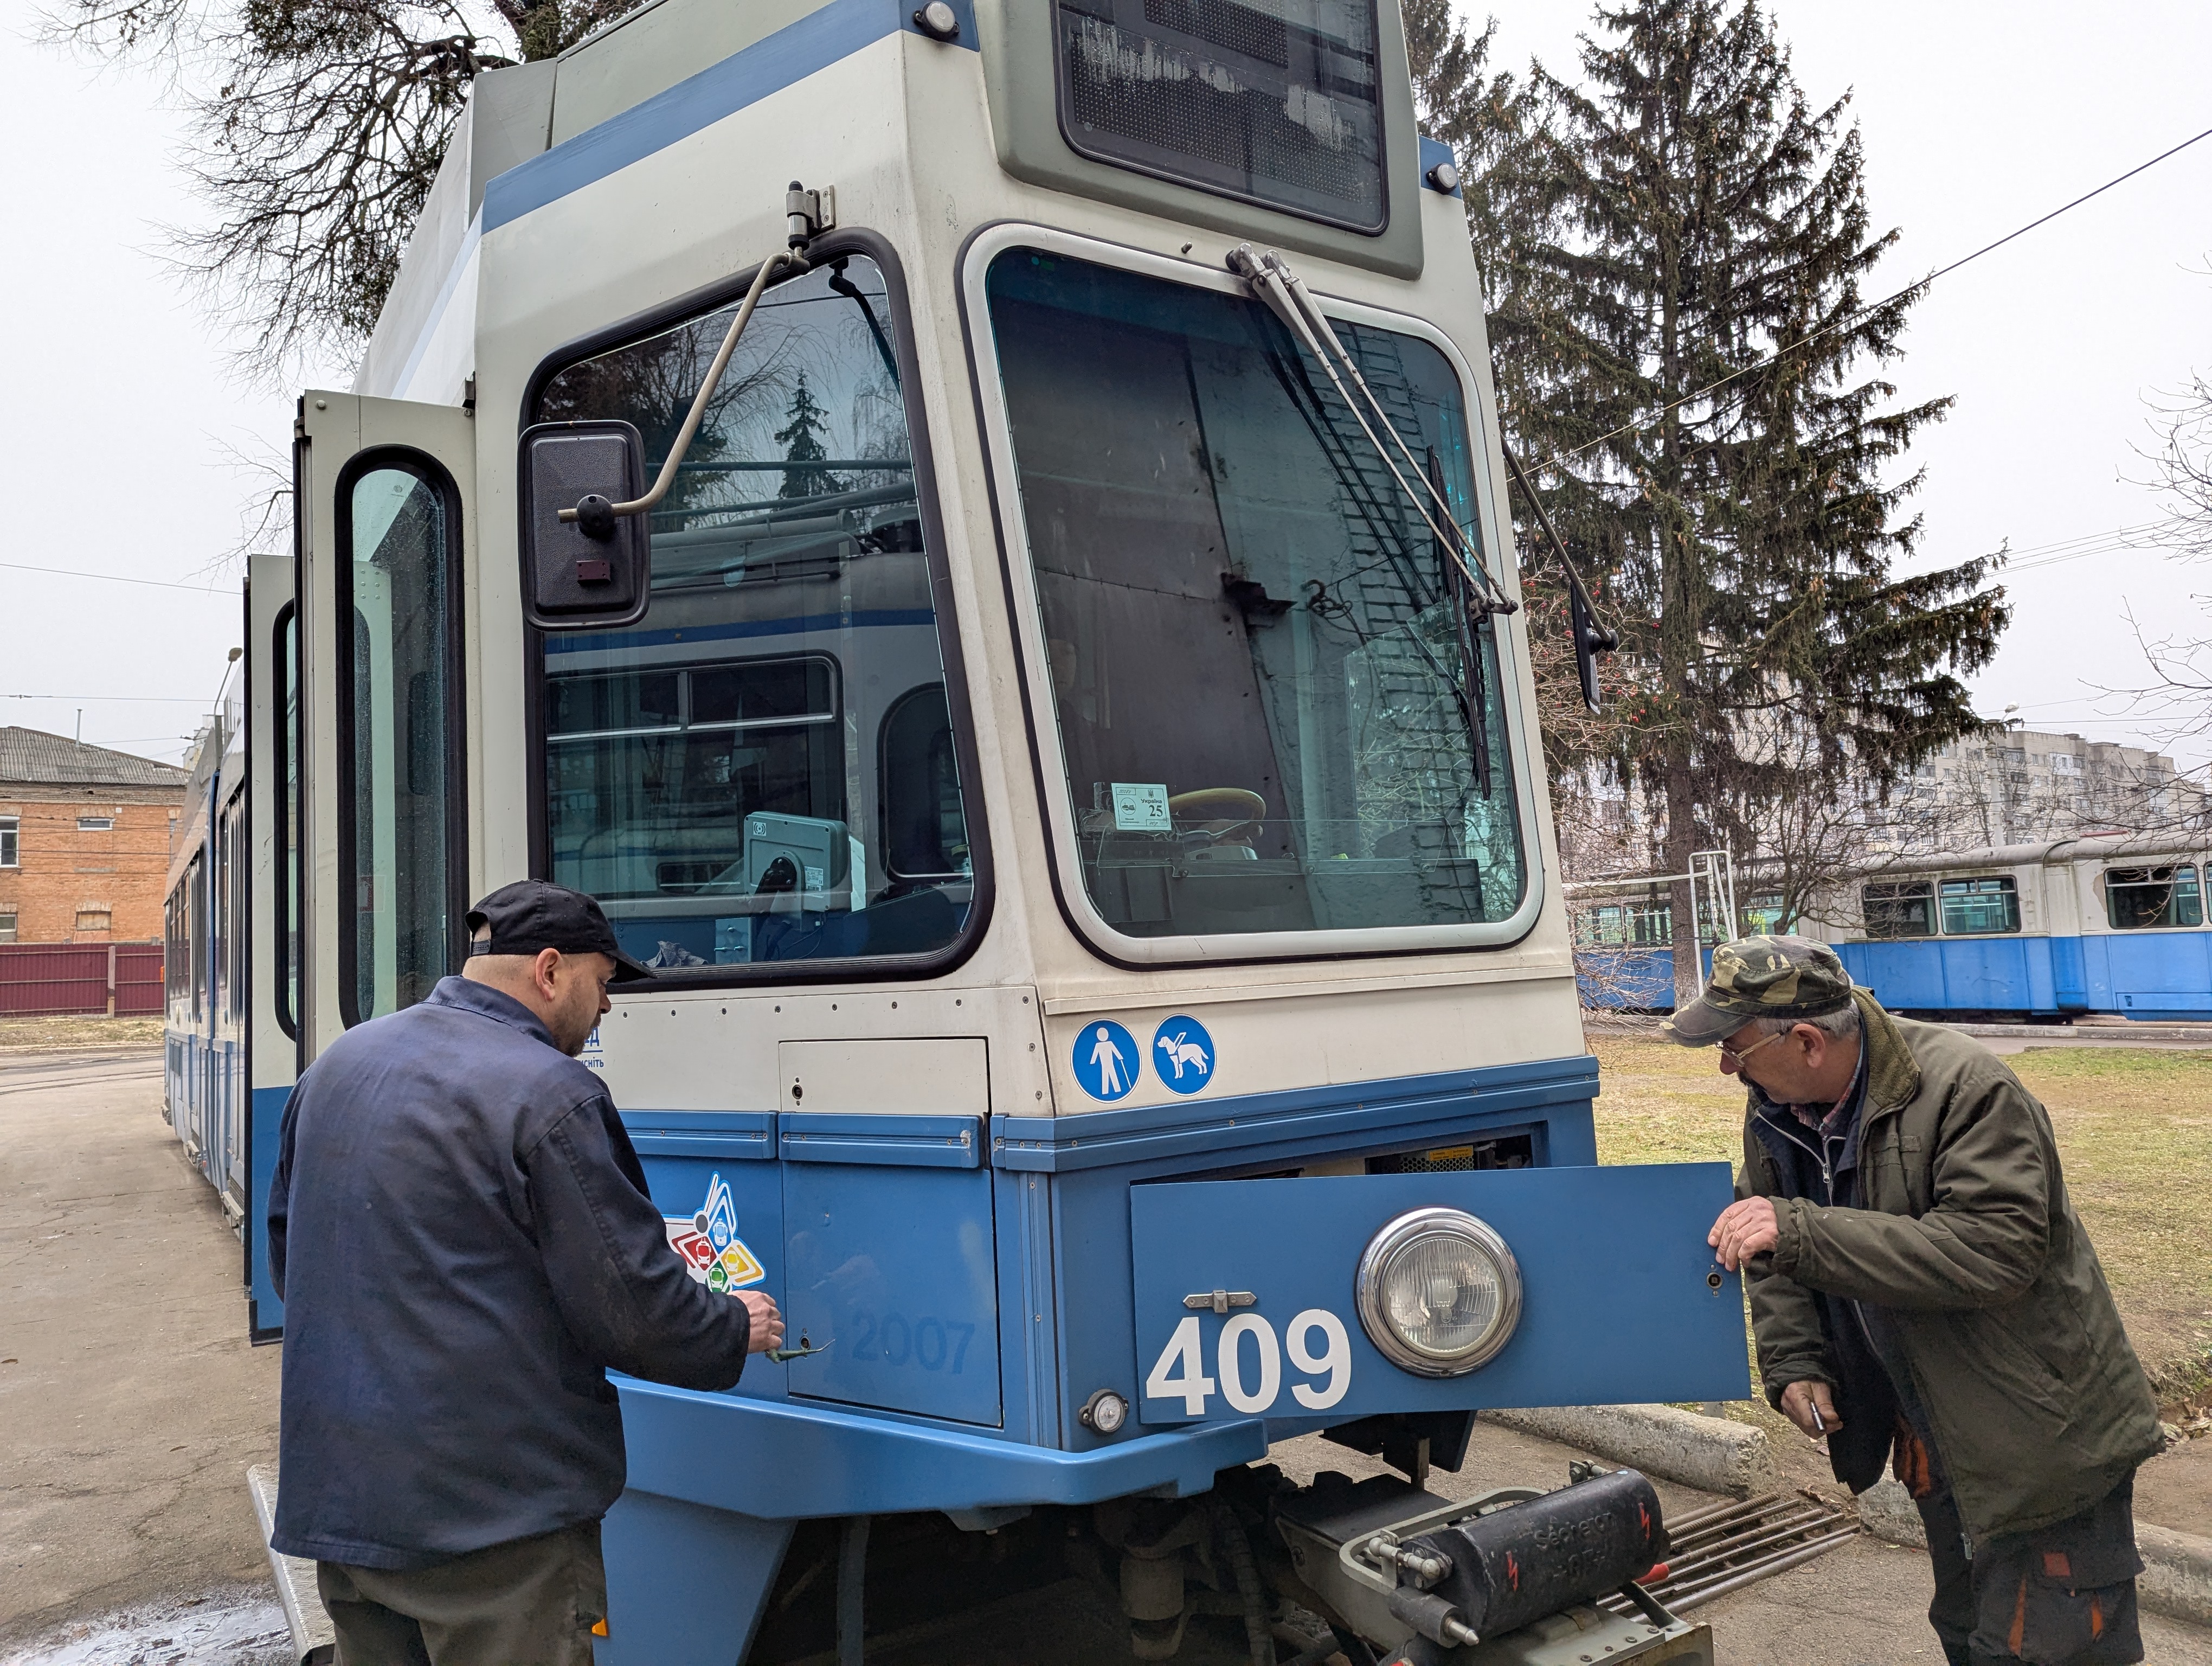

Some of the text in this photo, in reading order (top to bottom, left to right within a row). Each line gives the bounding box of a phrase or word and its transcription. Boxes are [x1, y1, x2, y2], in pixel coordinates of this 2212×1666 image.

[1149, 805, 1163, 817] 25
[852, 1310, 975, 1374] 2007
[1146, 1309, 1352, 1415] 409
